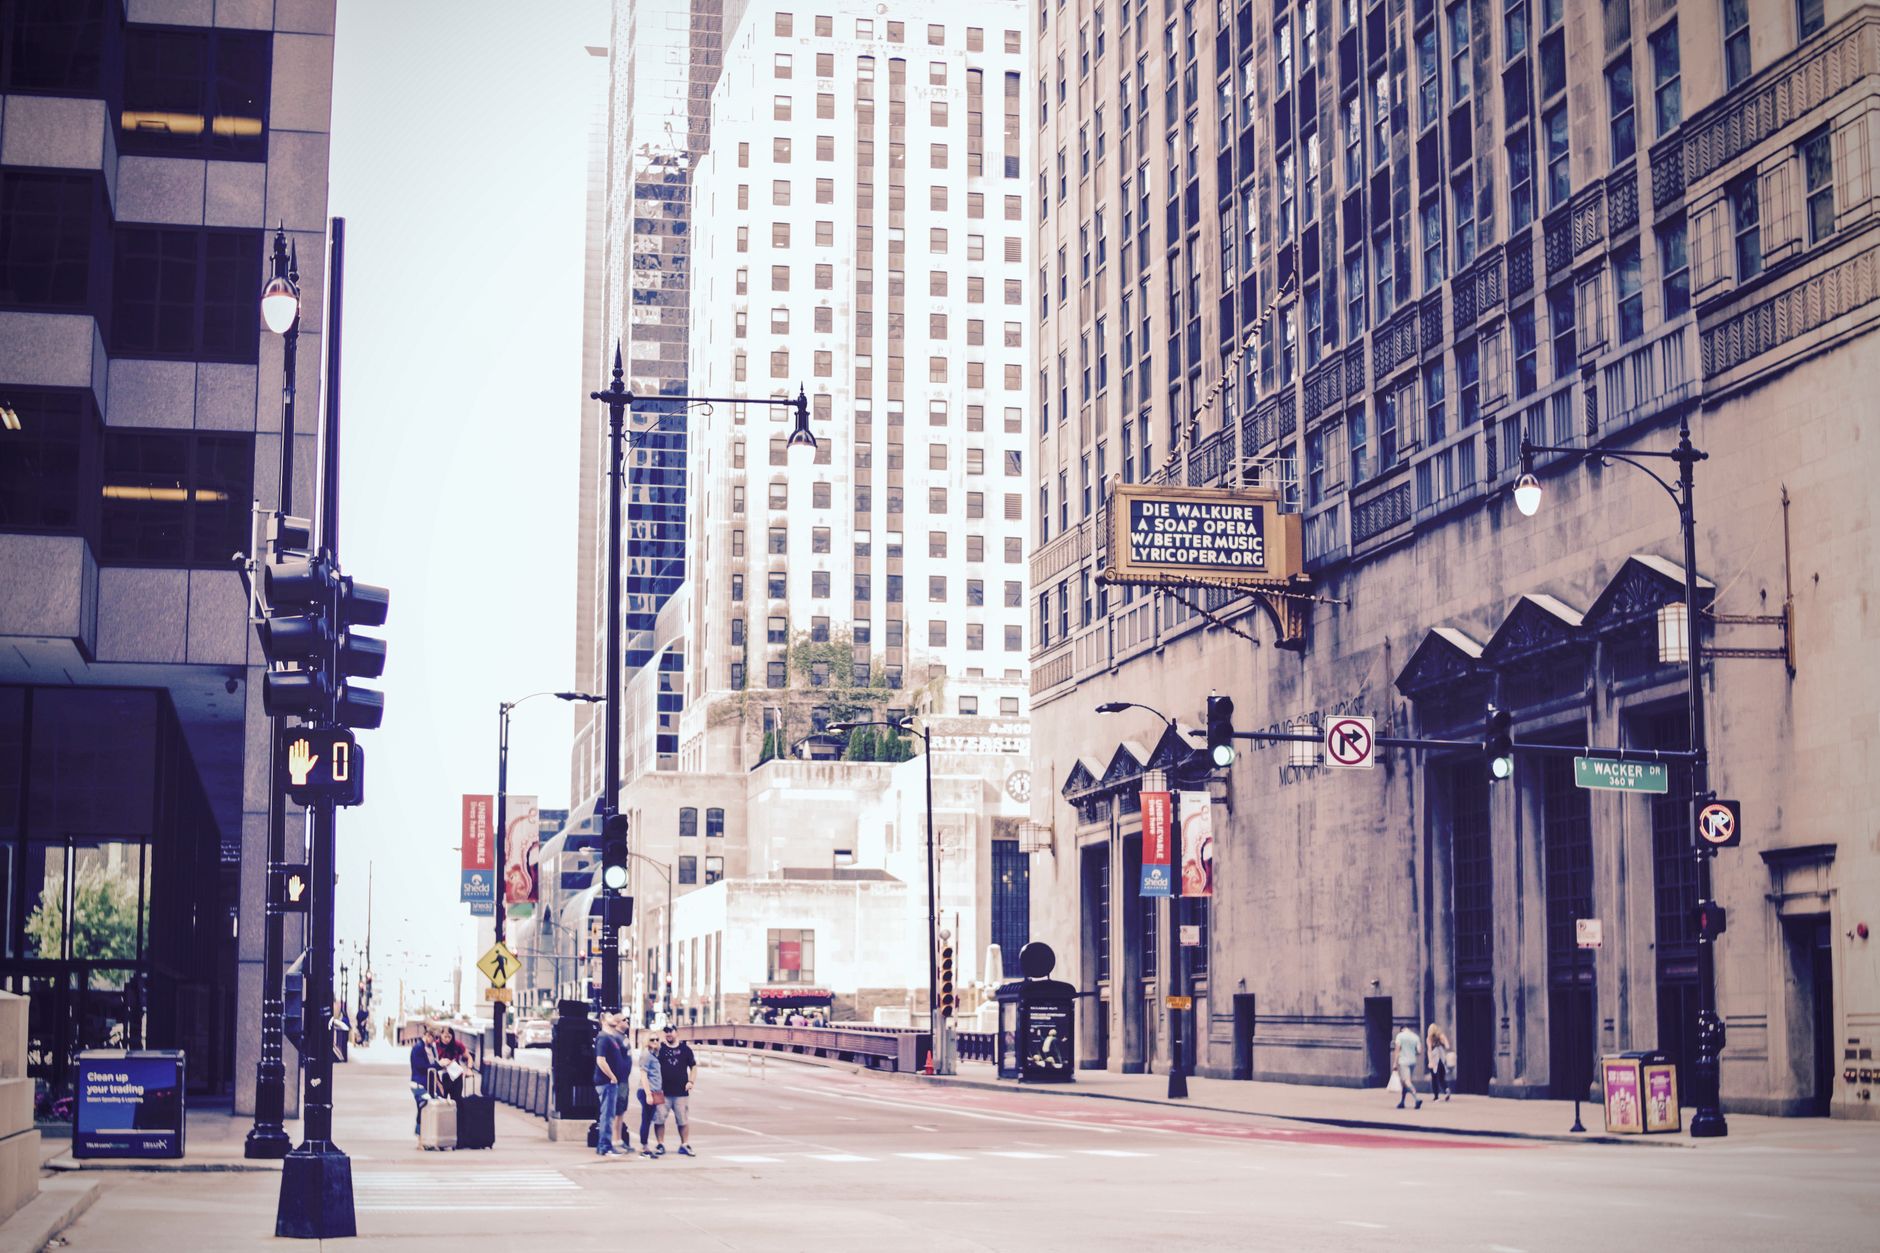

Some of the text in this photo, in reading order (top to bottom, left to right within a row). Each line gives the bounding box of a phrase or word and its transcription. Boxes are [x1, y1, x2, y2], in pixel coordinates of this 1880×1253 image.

[1142, 502, 1253, 521] DIE WALKURE
[1137, 517, 1257, 535] A SOAP OPERA
[1131, 532, 1263, 550] W/BETTER MUSIC
[1131, 547, 1264, 565] LYRICOPERA.ORG
[332, 741, 349, 782] 0
[1581, 761, 1661, 778] S WACKER DR
[1609, 776, 1635, 787] 360 W
[477, 801, 486, 864] UNBELIEVABLE
[1155, 799, 1164, 859] UNBELIEVABLE
[463, 883, 490, 893] Shedd
[1144, 877, 1168, 887] Shedd
[87, 1072, 129, 1084] Clean up
[87, 1084, 145, 1095] your trading
